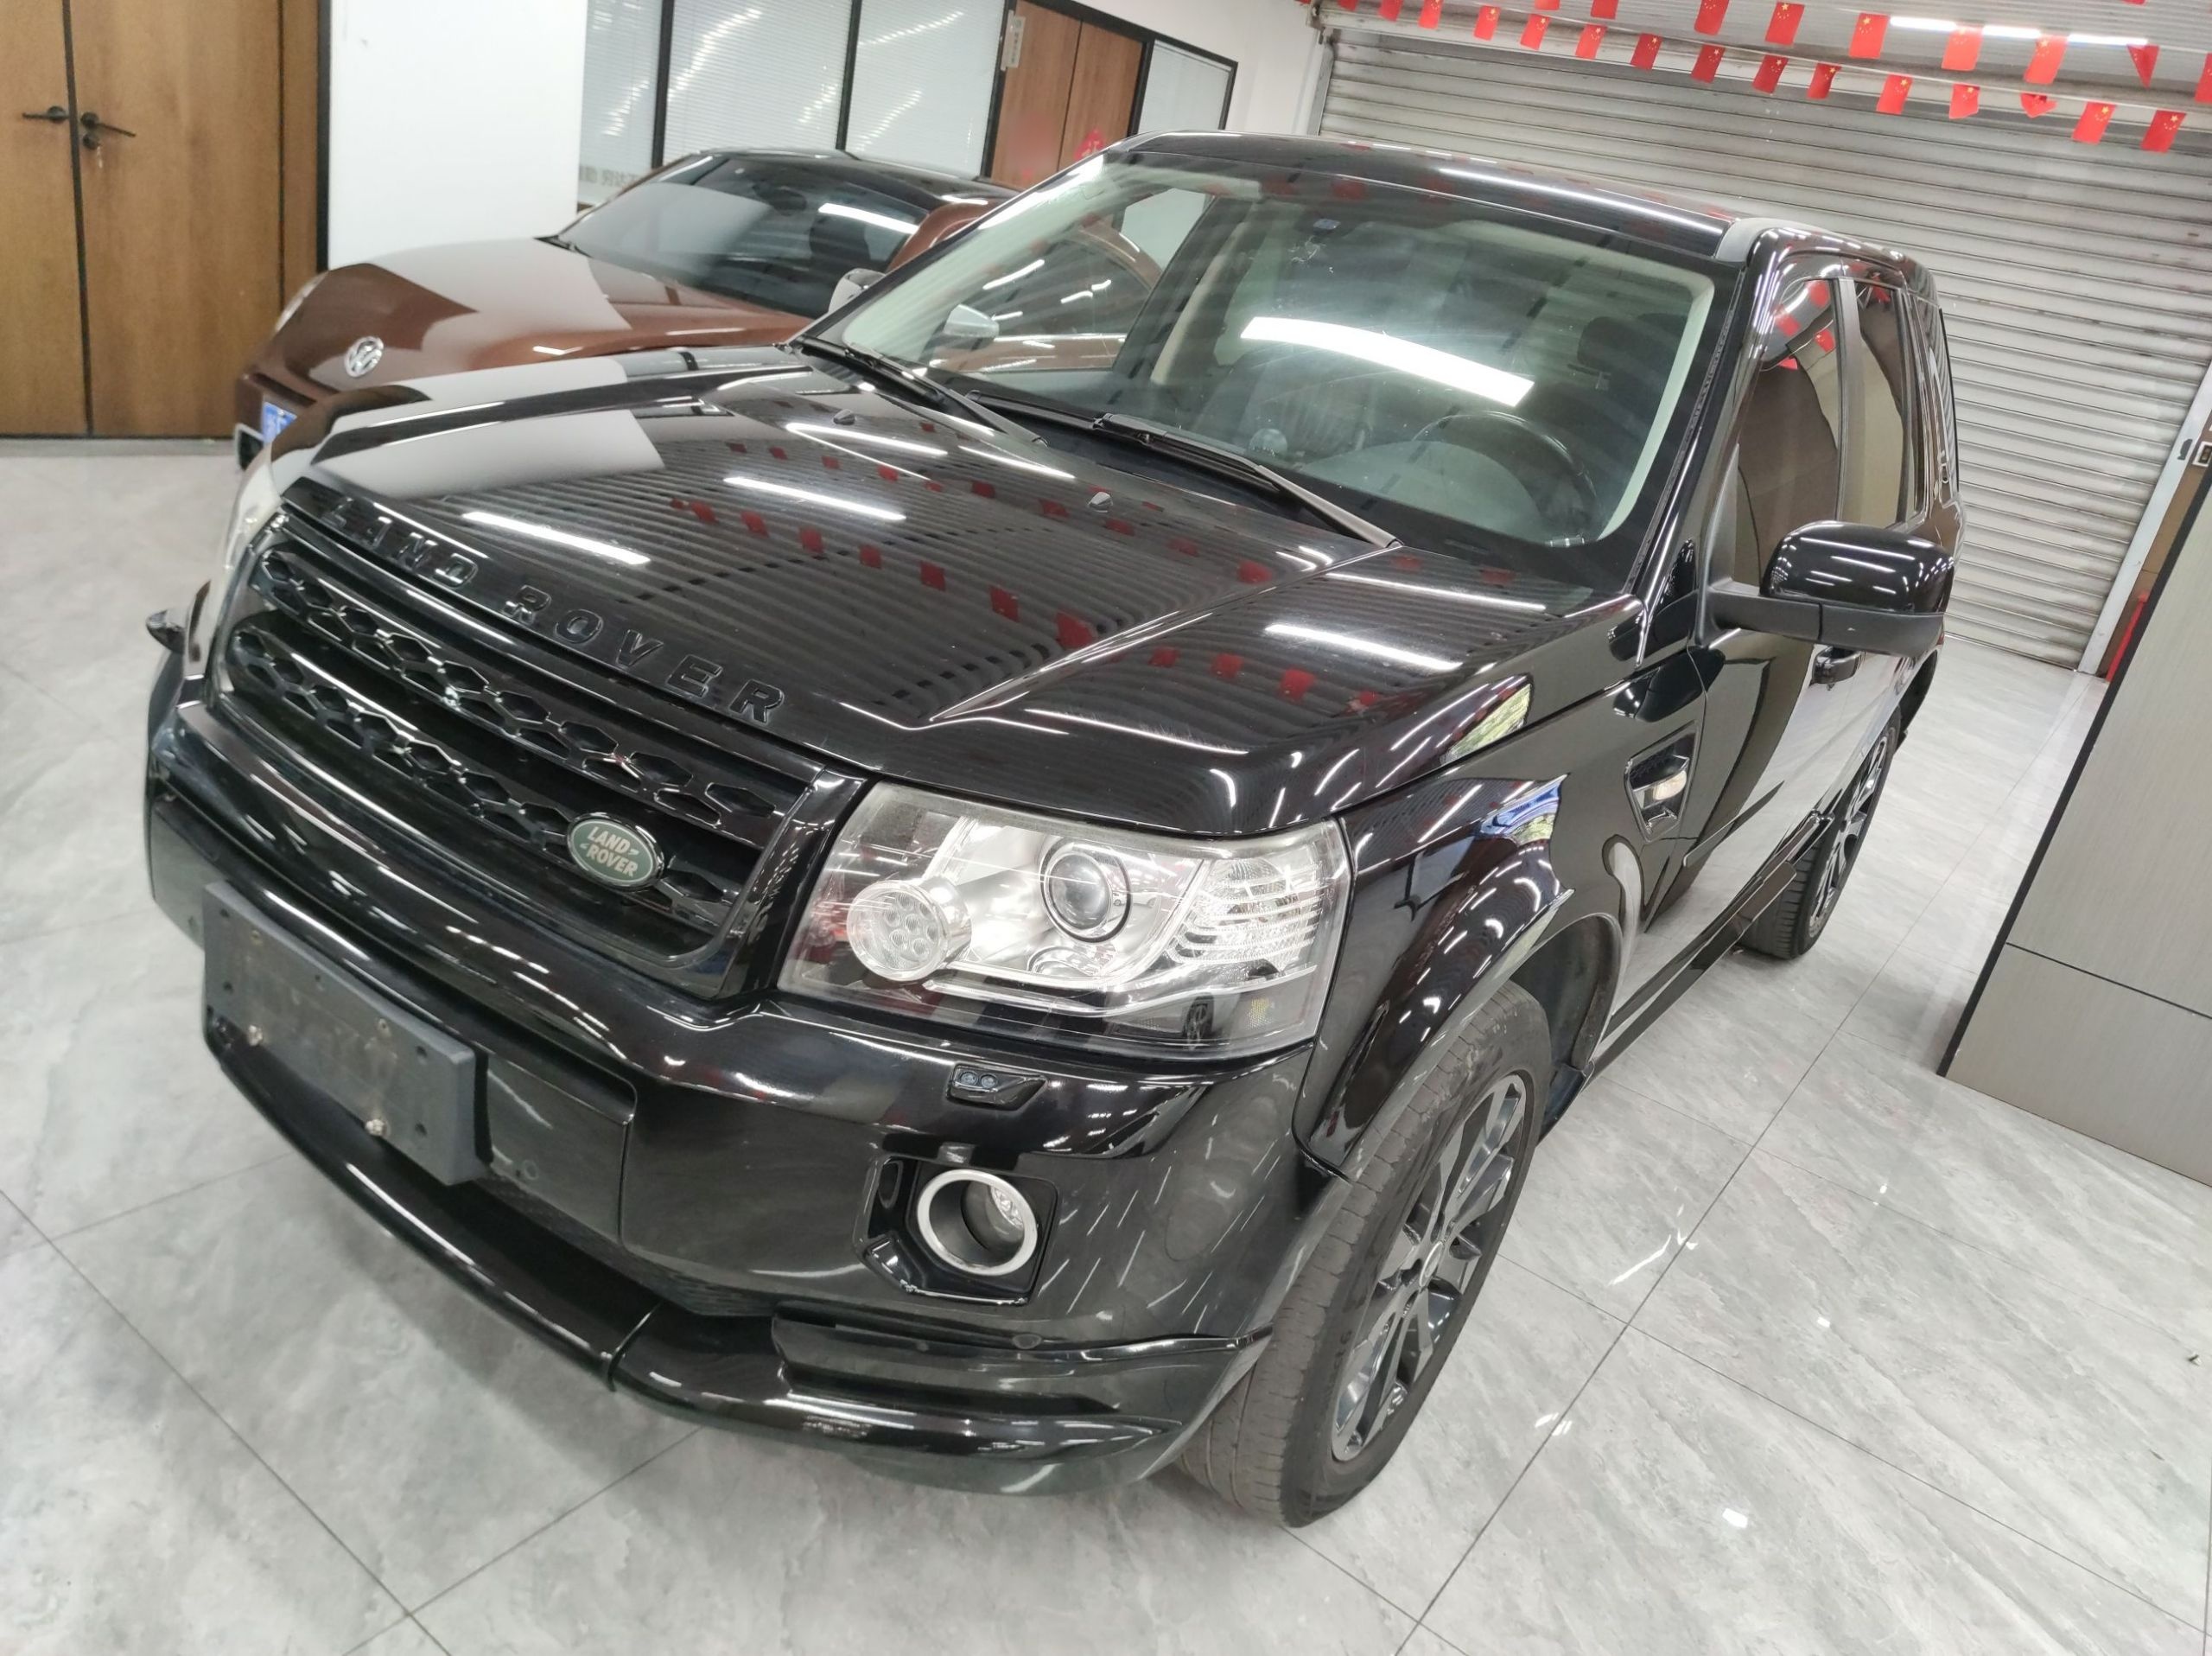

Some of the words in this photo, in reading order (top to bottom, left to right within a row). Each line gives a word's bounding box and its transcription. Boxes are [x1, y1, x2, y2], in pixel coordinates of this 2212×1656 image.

[501, 584, 785, 723] ROVER
[587, 826, 631, 854] LAND
[586, 844, 639, 877] ROVER
